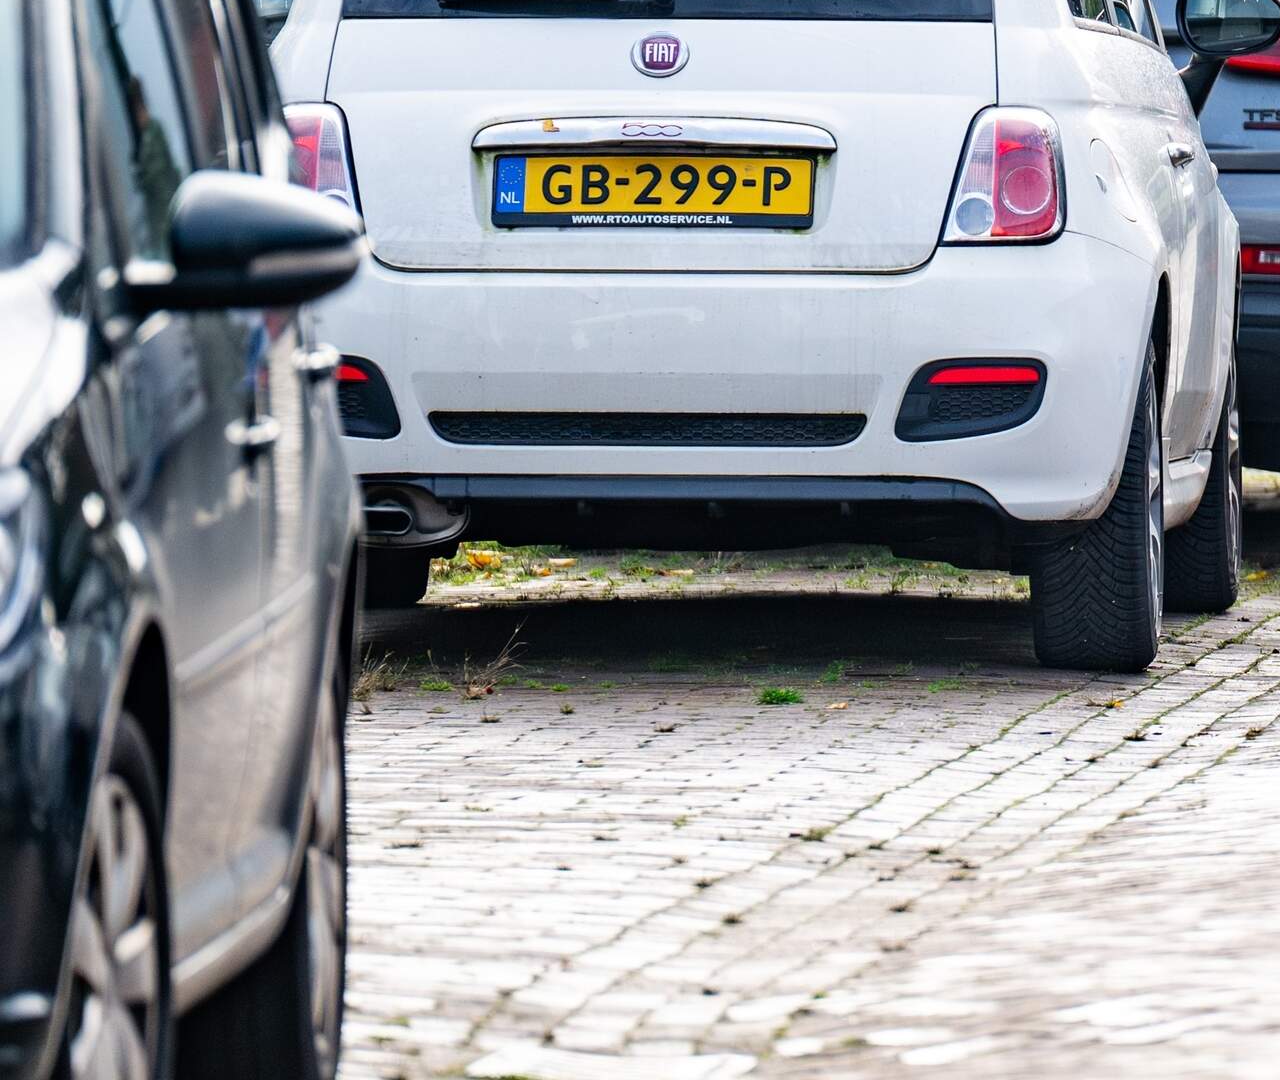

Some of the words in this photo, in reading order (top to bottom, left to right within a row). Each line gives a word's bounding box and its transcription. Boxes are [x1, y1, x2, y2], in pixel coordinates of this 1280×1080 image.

[645, 42, 678, 63] FIAT
[500, 191, 520, 204] NL
[541, 163, 793, 207] GB-299-P
[572, 214, 734, 225] WWW.RTOAUTOSERVICE.NL
